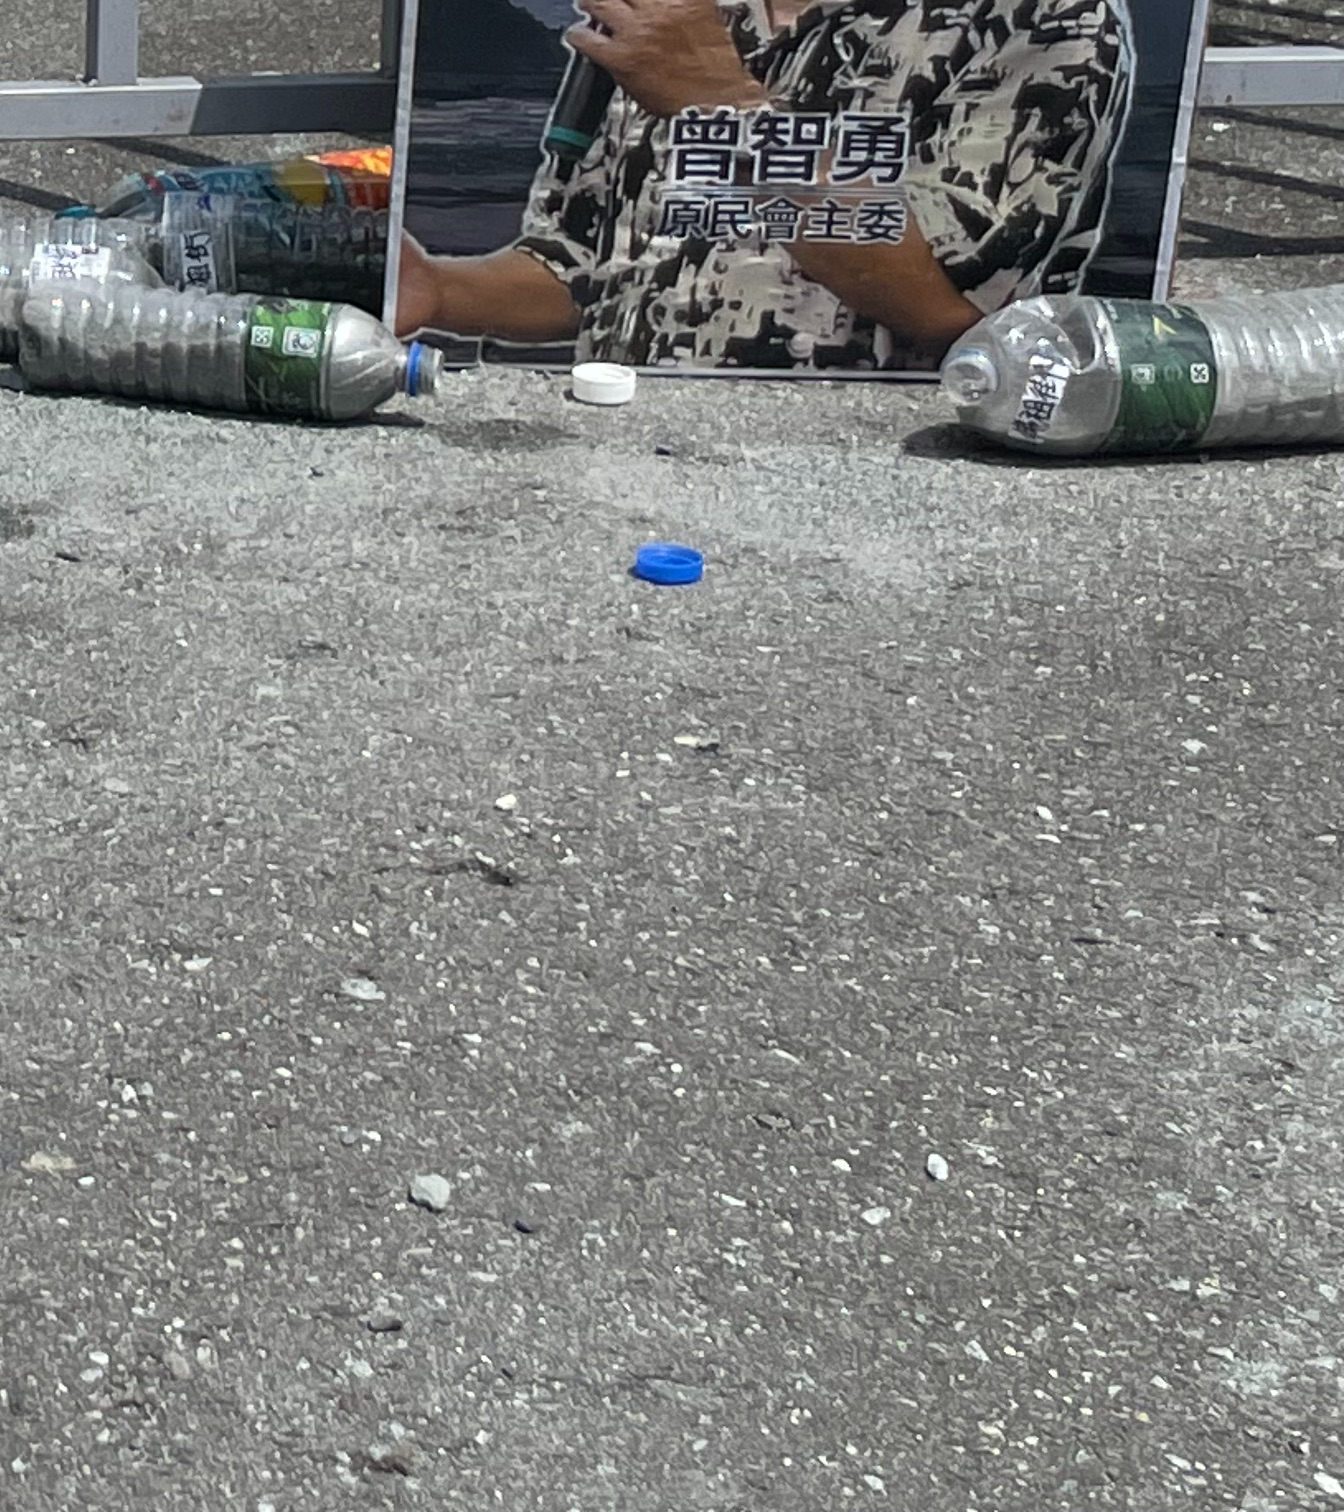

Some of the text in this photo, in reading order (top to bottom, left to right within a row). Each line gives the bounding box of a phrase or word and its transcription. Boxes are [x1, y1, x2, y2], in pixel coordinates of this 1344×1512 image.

[671, 107, 908, 184] 曾智勇
[659, 196, 906, 244] 原民會主委
